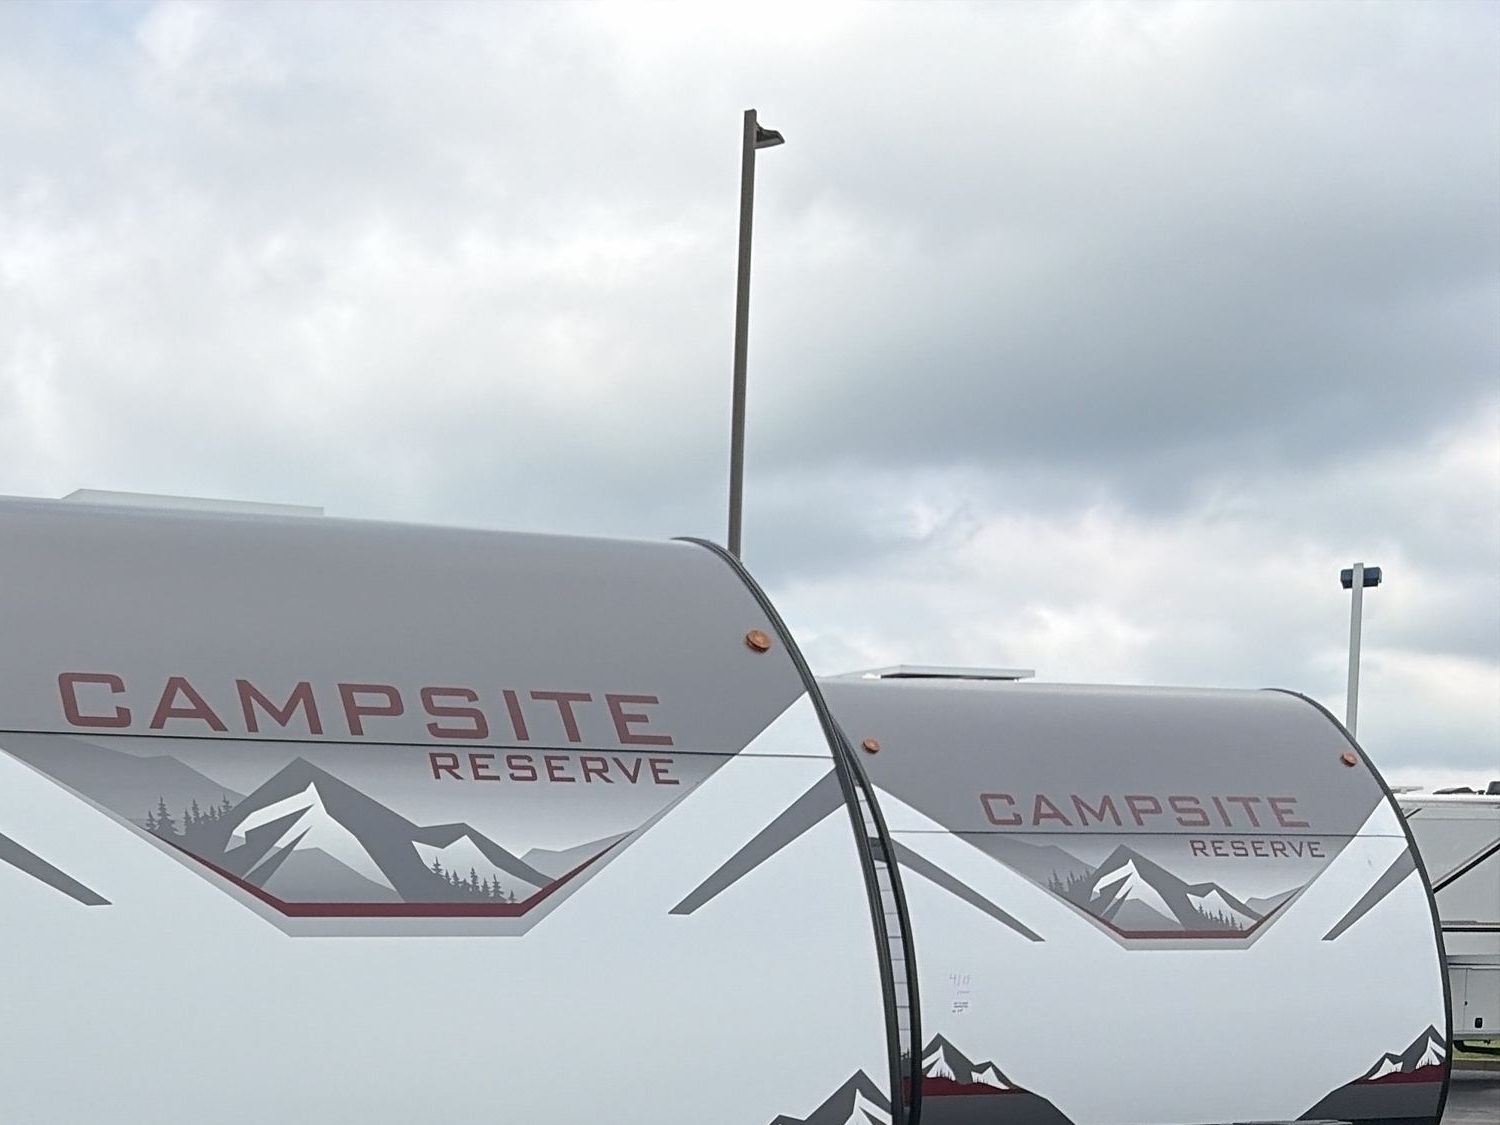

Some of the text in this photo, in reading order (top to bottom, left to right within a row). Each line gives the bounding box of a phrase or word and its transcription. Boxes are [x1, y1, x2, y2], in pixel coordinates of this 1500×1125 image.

[57, 672, 676, 746] CAMPSITE
[428, 752, 681, 786] RESERVE
[979, 793, 1310, 829] CAMPSITE
[1189, 839, 1326, 858] RESERVE
